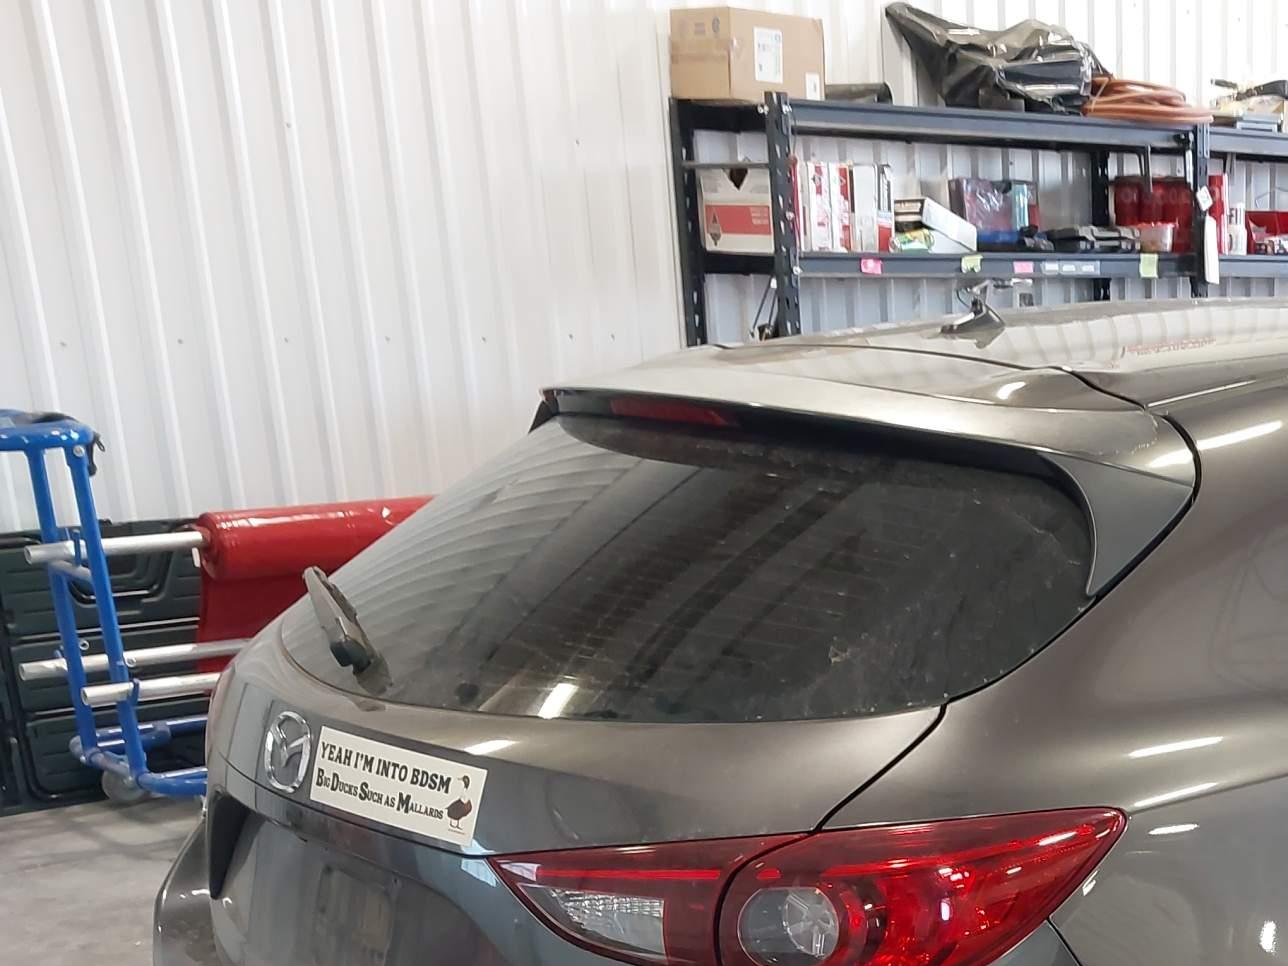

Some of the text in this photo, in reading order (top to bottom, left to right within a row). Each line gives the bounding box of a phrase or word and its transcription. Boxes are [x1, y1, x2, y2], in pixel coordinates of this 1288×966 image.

[320, 742, 452, 794] YEAH I'M INTO BDSM
